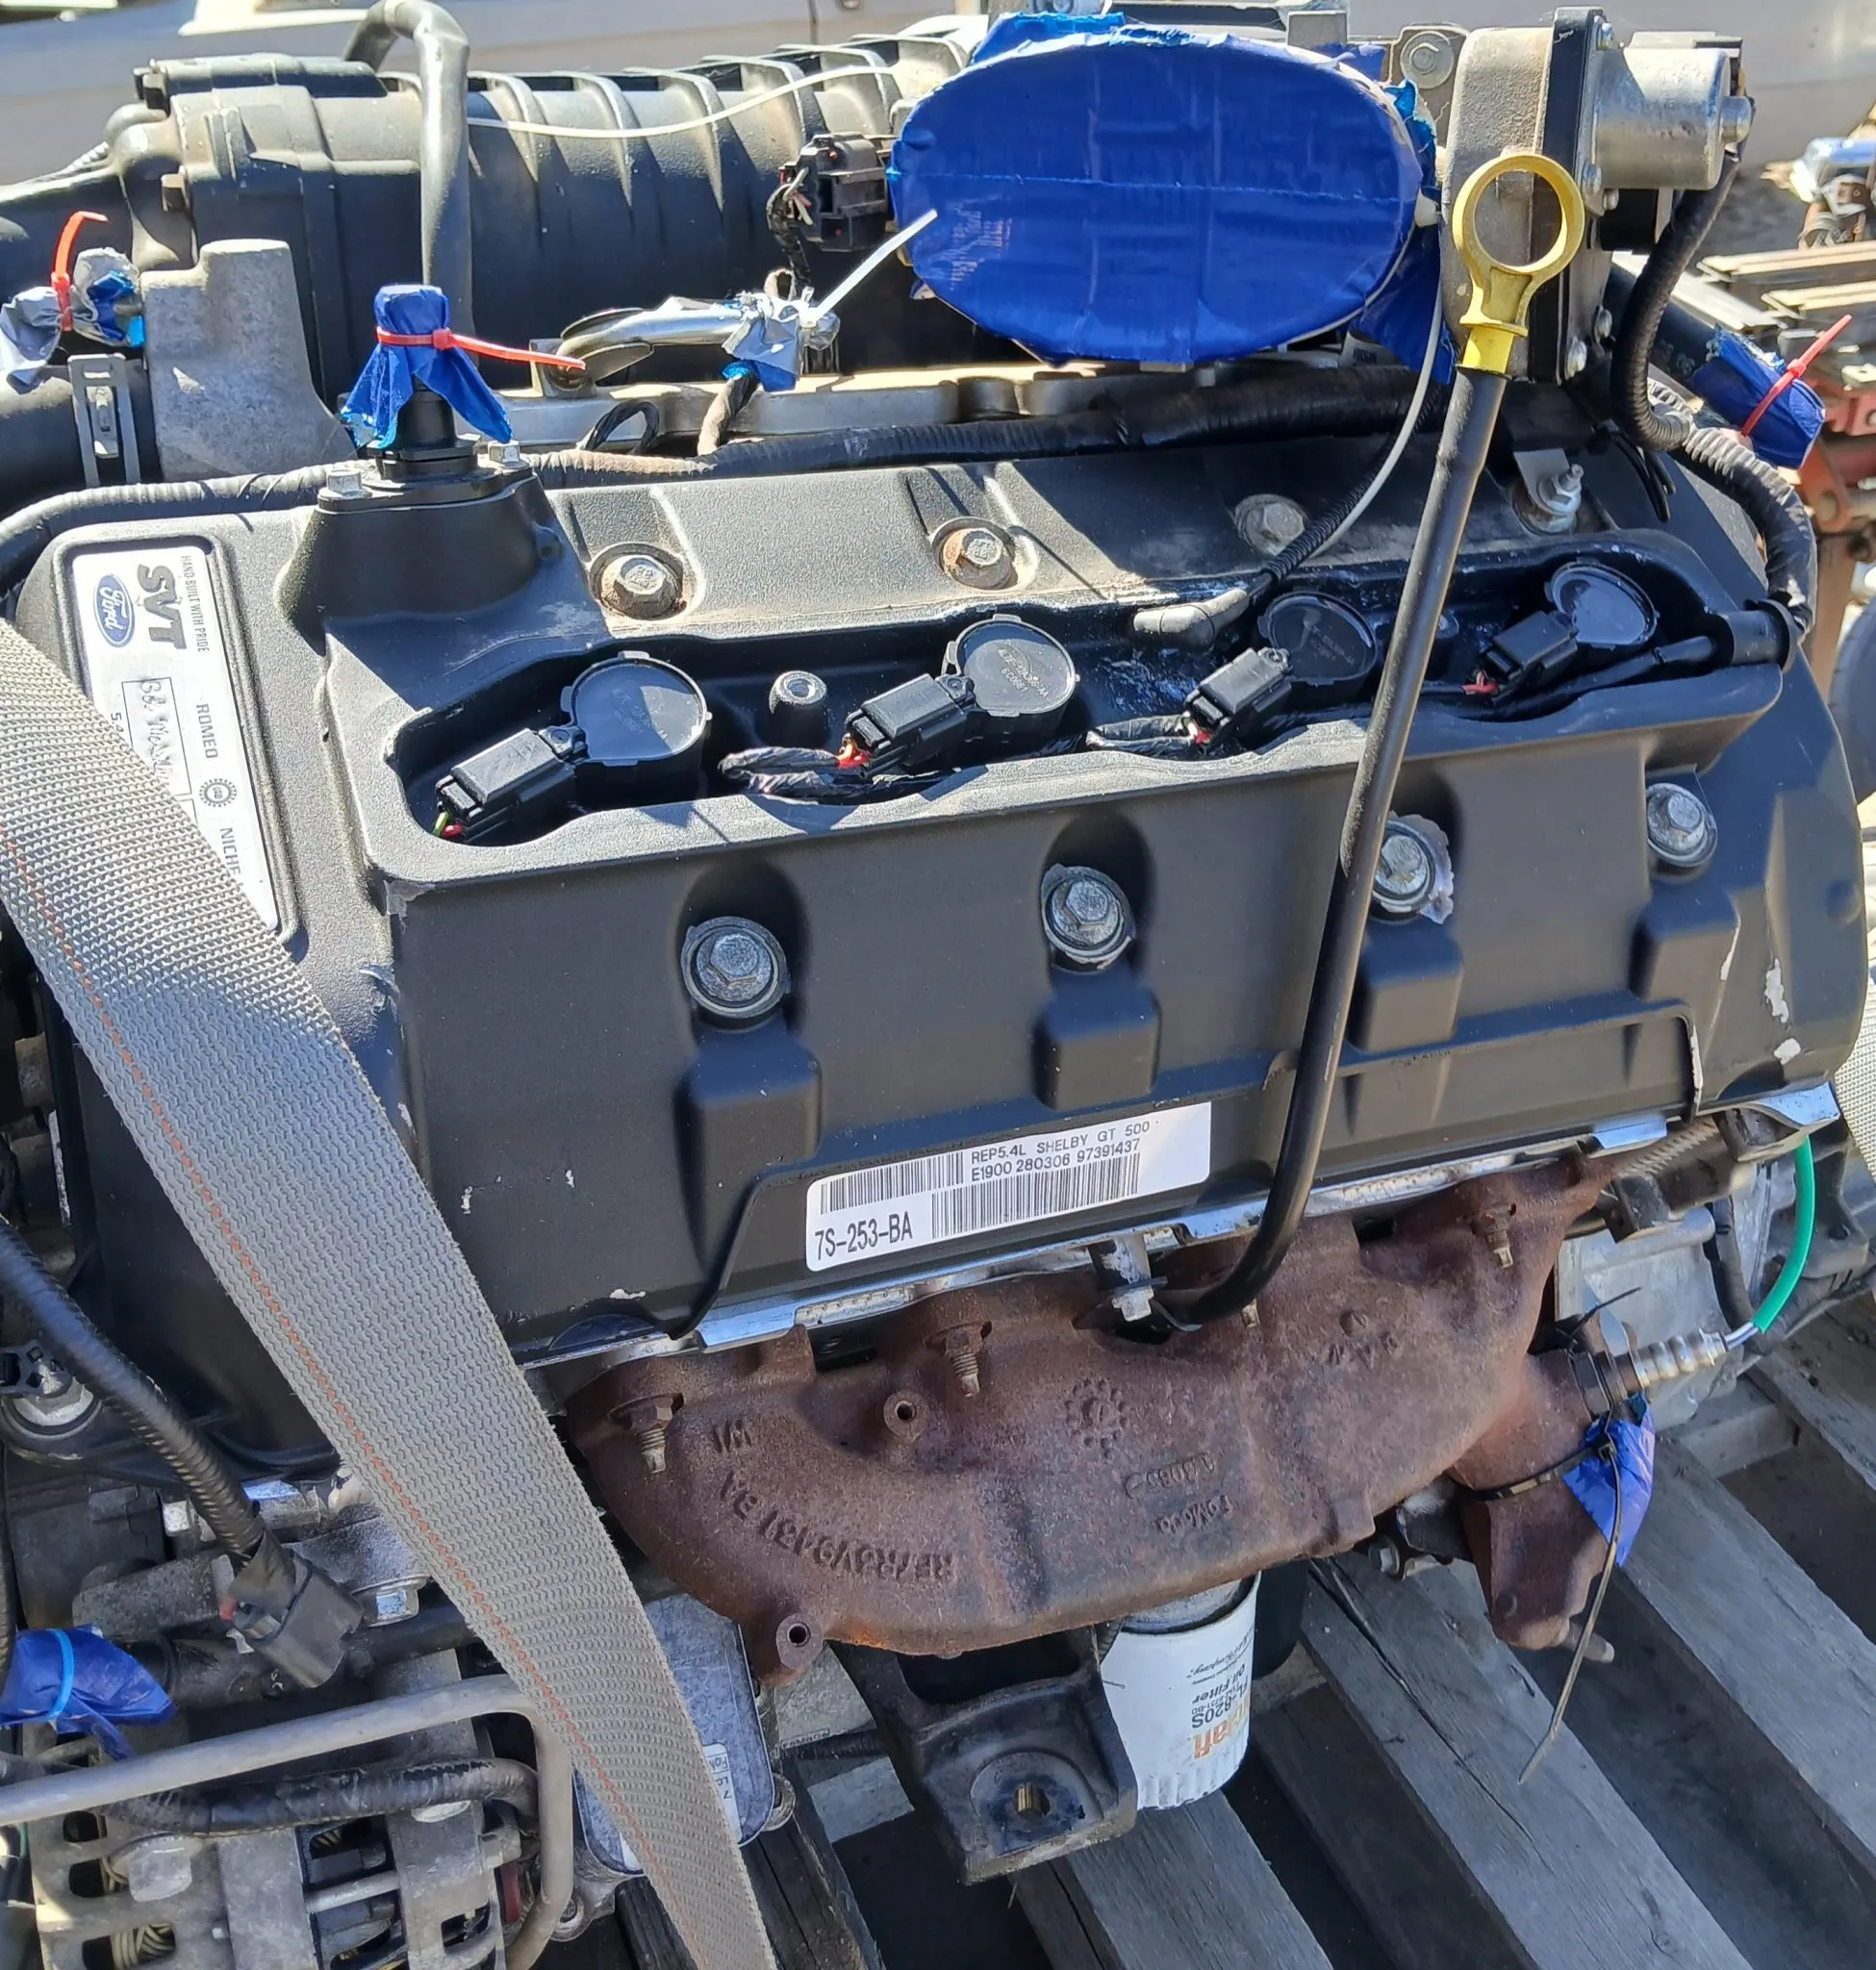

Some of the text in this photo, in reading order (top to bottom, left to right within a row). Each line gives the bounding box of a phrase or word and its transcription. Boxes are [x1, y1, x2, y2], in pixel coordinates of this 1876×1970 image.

[137, 564, 187, 649] SVT
[190, 605, 204, 626] WITH
[195, 626, 210, 653] PRIDE
[196, 703, 218, 759] ROMEO
[971, 1121, 1151, 1164] REP5.4L SHELBY GT 500
[971, 1138, 1141, 1182] E1900 280306 97391437
[814, 1210, 913, 1261] 7S-253-BA
[1192, 1677, 1230, 1705] Filter
